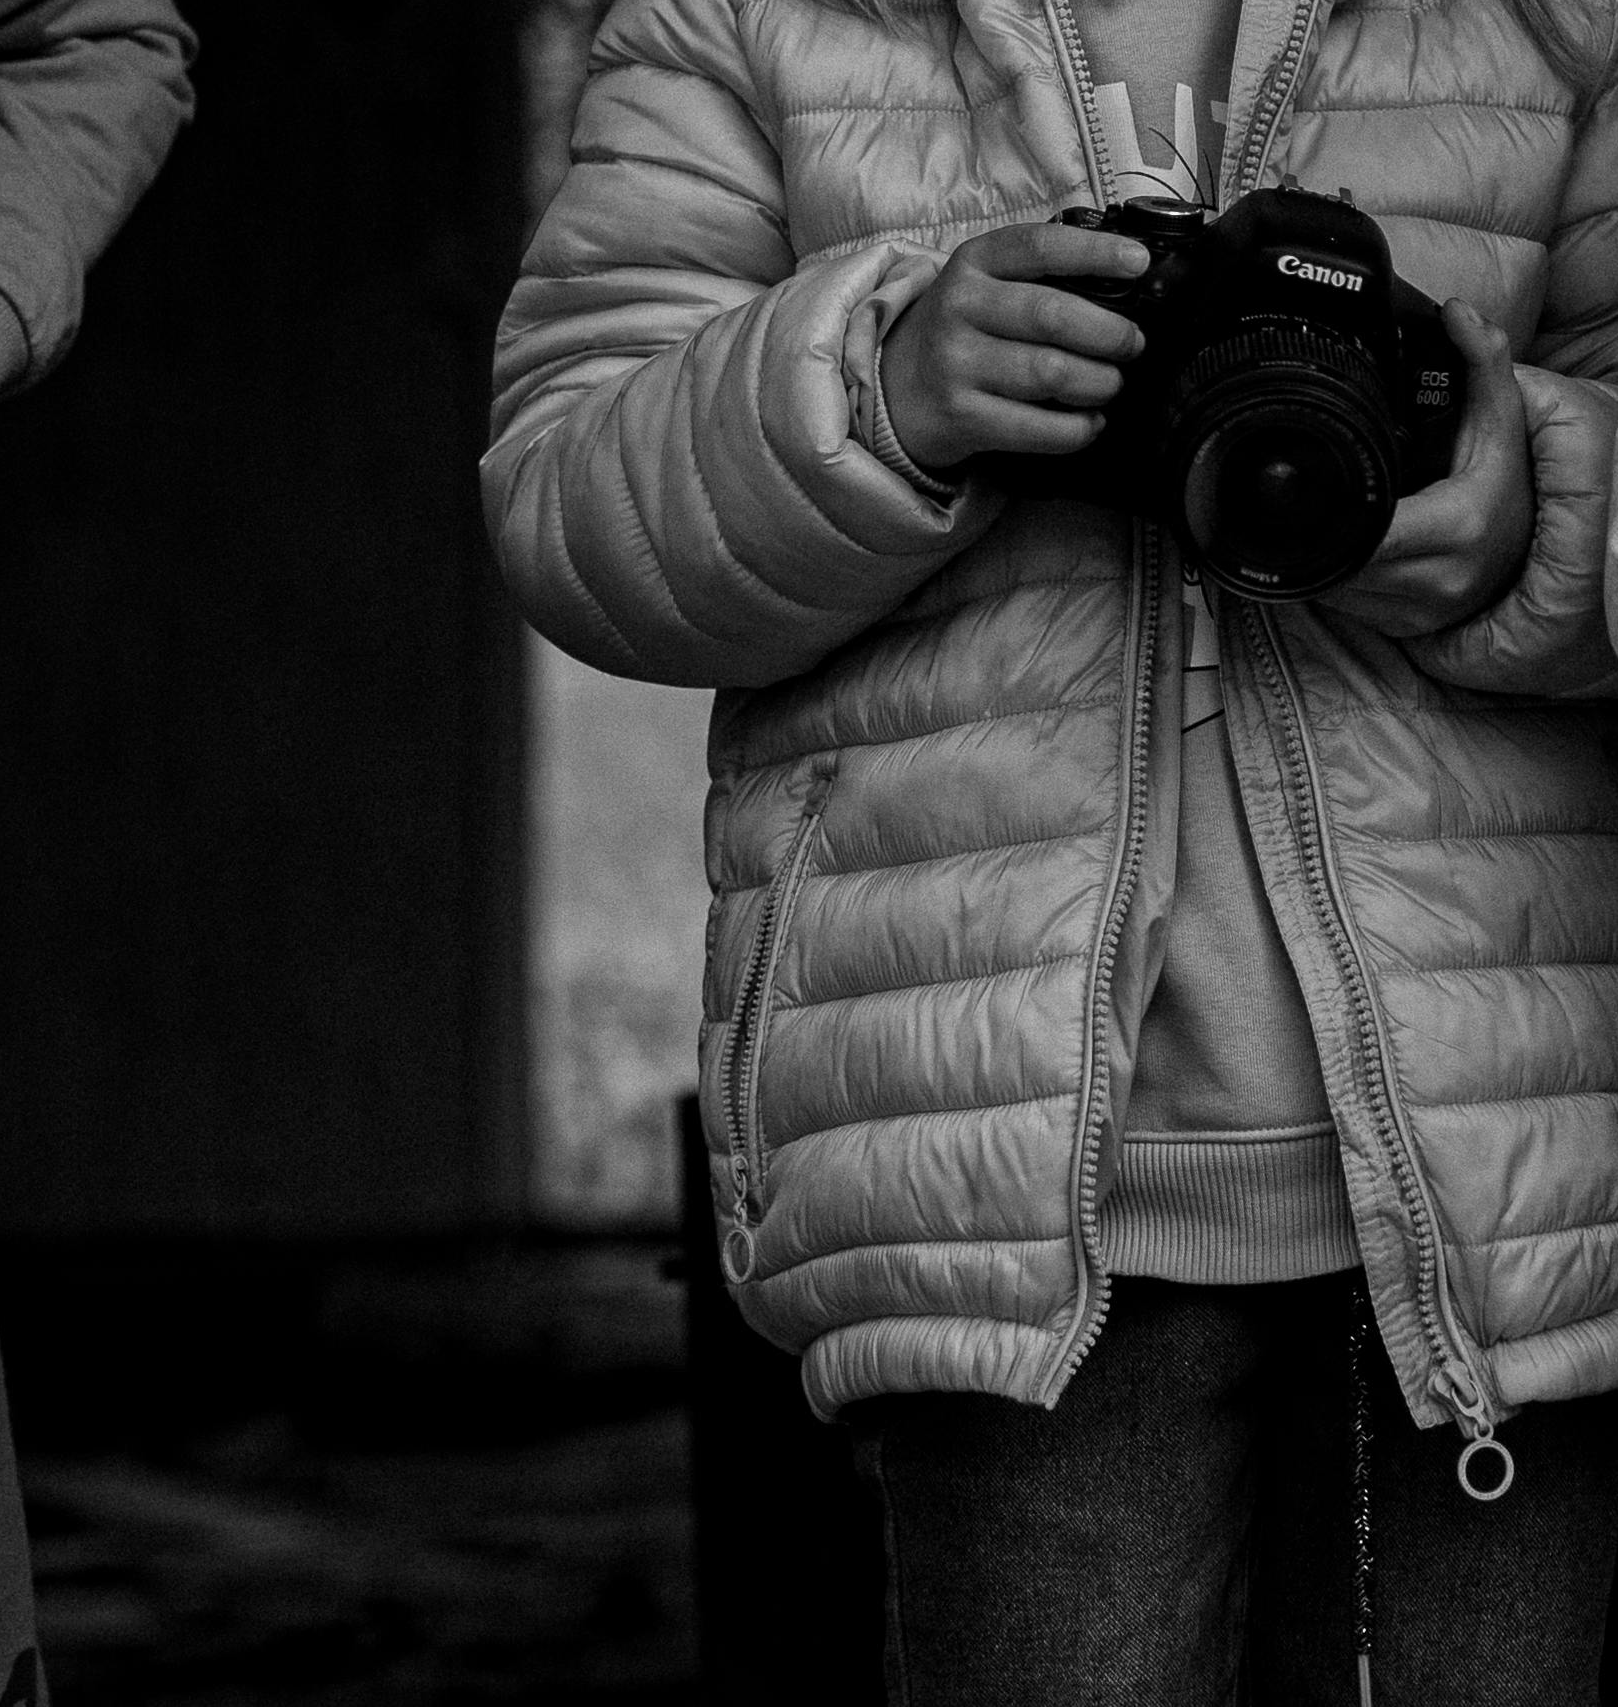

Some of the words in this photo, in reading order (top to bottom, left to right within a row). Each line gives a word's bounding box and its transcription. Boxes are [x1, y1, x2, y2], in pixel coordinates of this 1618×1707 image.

[1277, 254, 1364, 293] Canon
[1420, 370, 1450, 388] EOS
[1415, 389, 1451, 407] 600D
